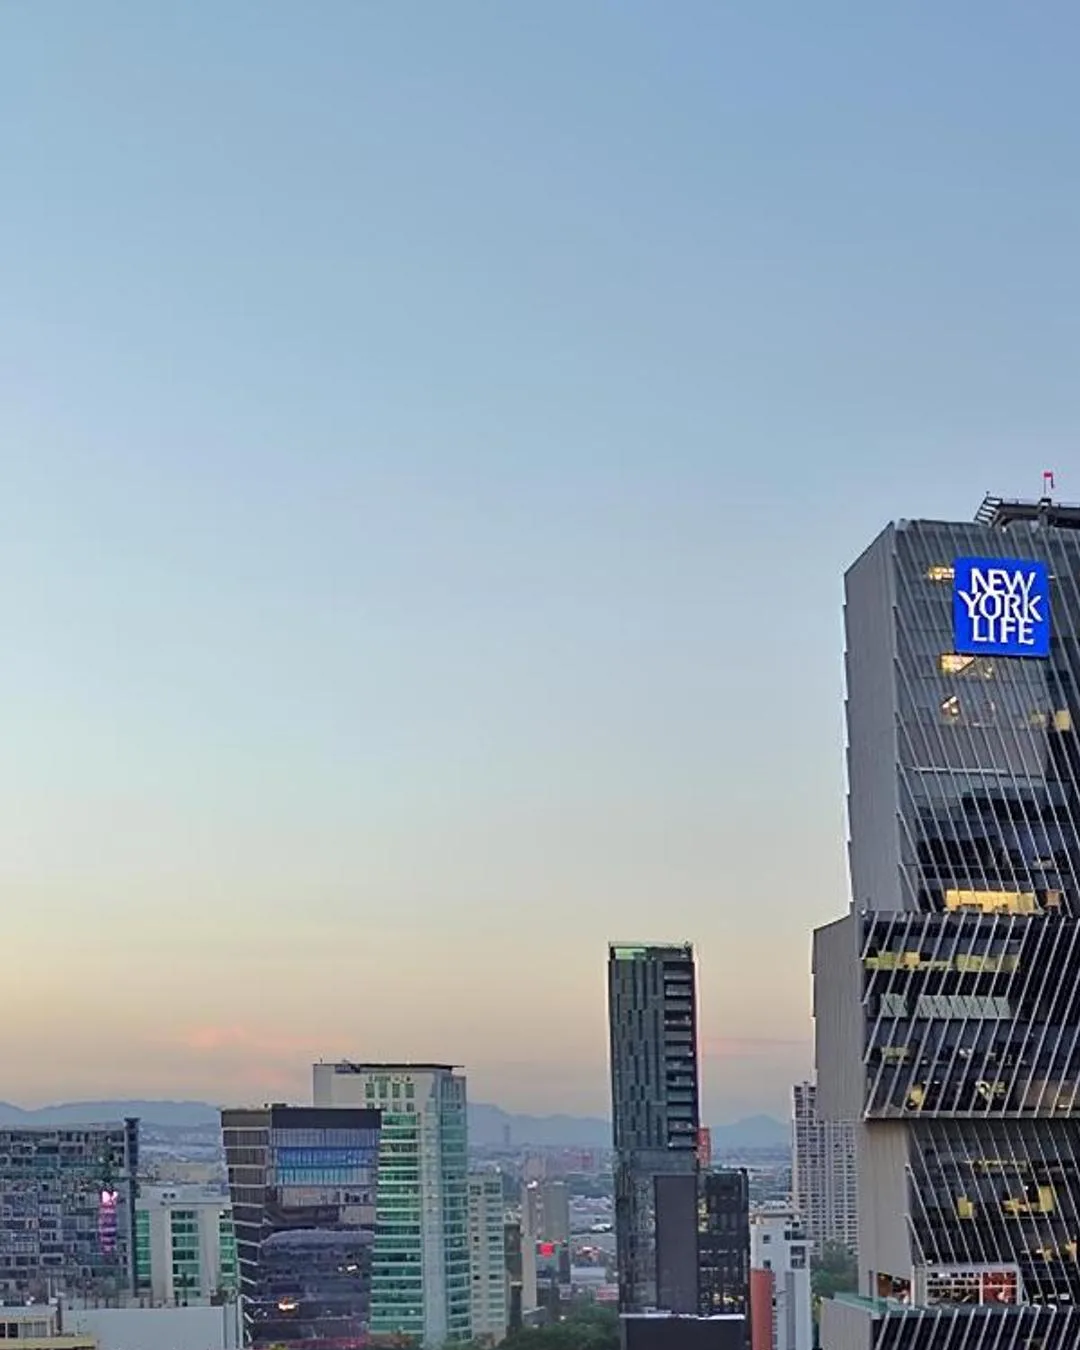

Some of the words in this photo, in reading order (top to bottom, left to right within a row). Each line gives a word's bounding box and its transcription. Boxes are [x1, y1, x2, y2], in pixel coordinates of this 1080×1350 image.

[970, 567, 1036, 595] NEW
[957, 590, 1043, 622] YORK
[972, 616, 1034, 645] LIFE
